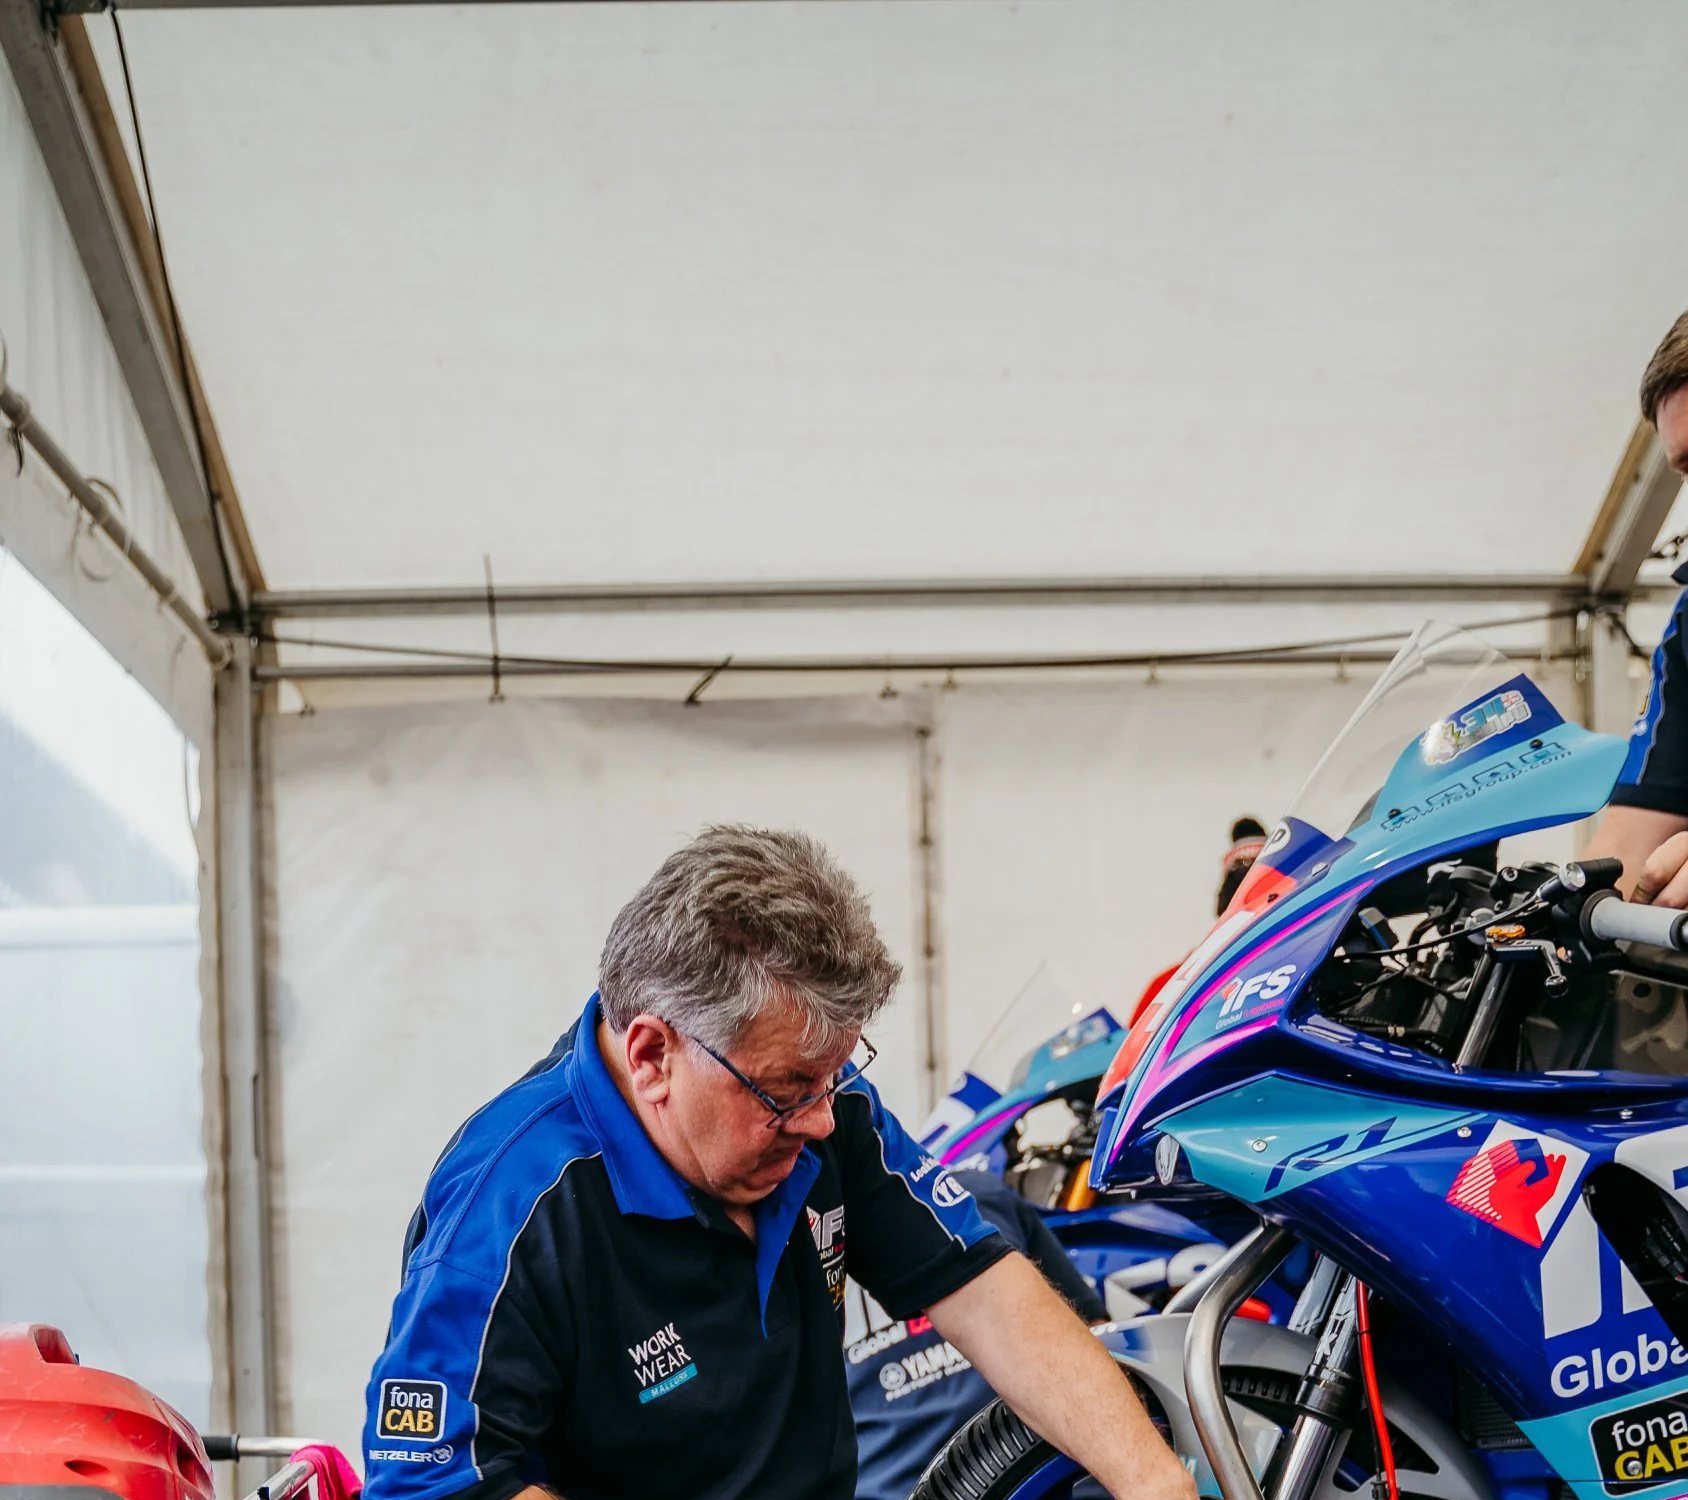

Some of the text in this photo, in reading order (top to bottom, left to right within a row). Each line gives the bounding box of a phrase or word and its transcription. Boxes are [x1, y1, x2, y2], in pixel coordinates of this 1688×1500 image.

[1388, 750, 1572, 832] www.ifsgroup.com
[627, 1322, 681, 1366] WORK
[633, 1343, 692, 1387] WEAR
[389, 1386, 434, 1409] fona
[384, 1408, 435, 1433] CAB
[1611, 1410, 1688, 1451] fona
